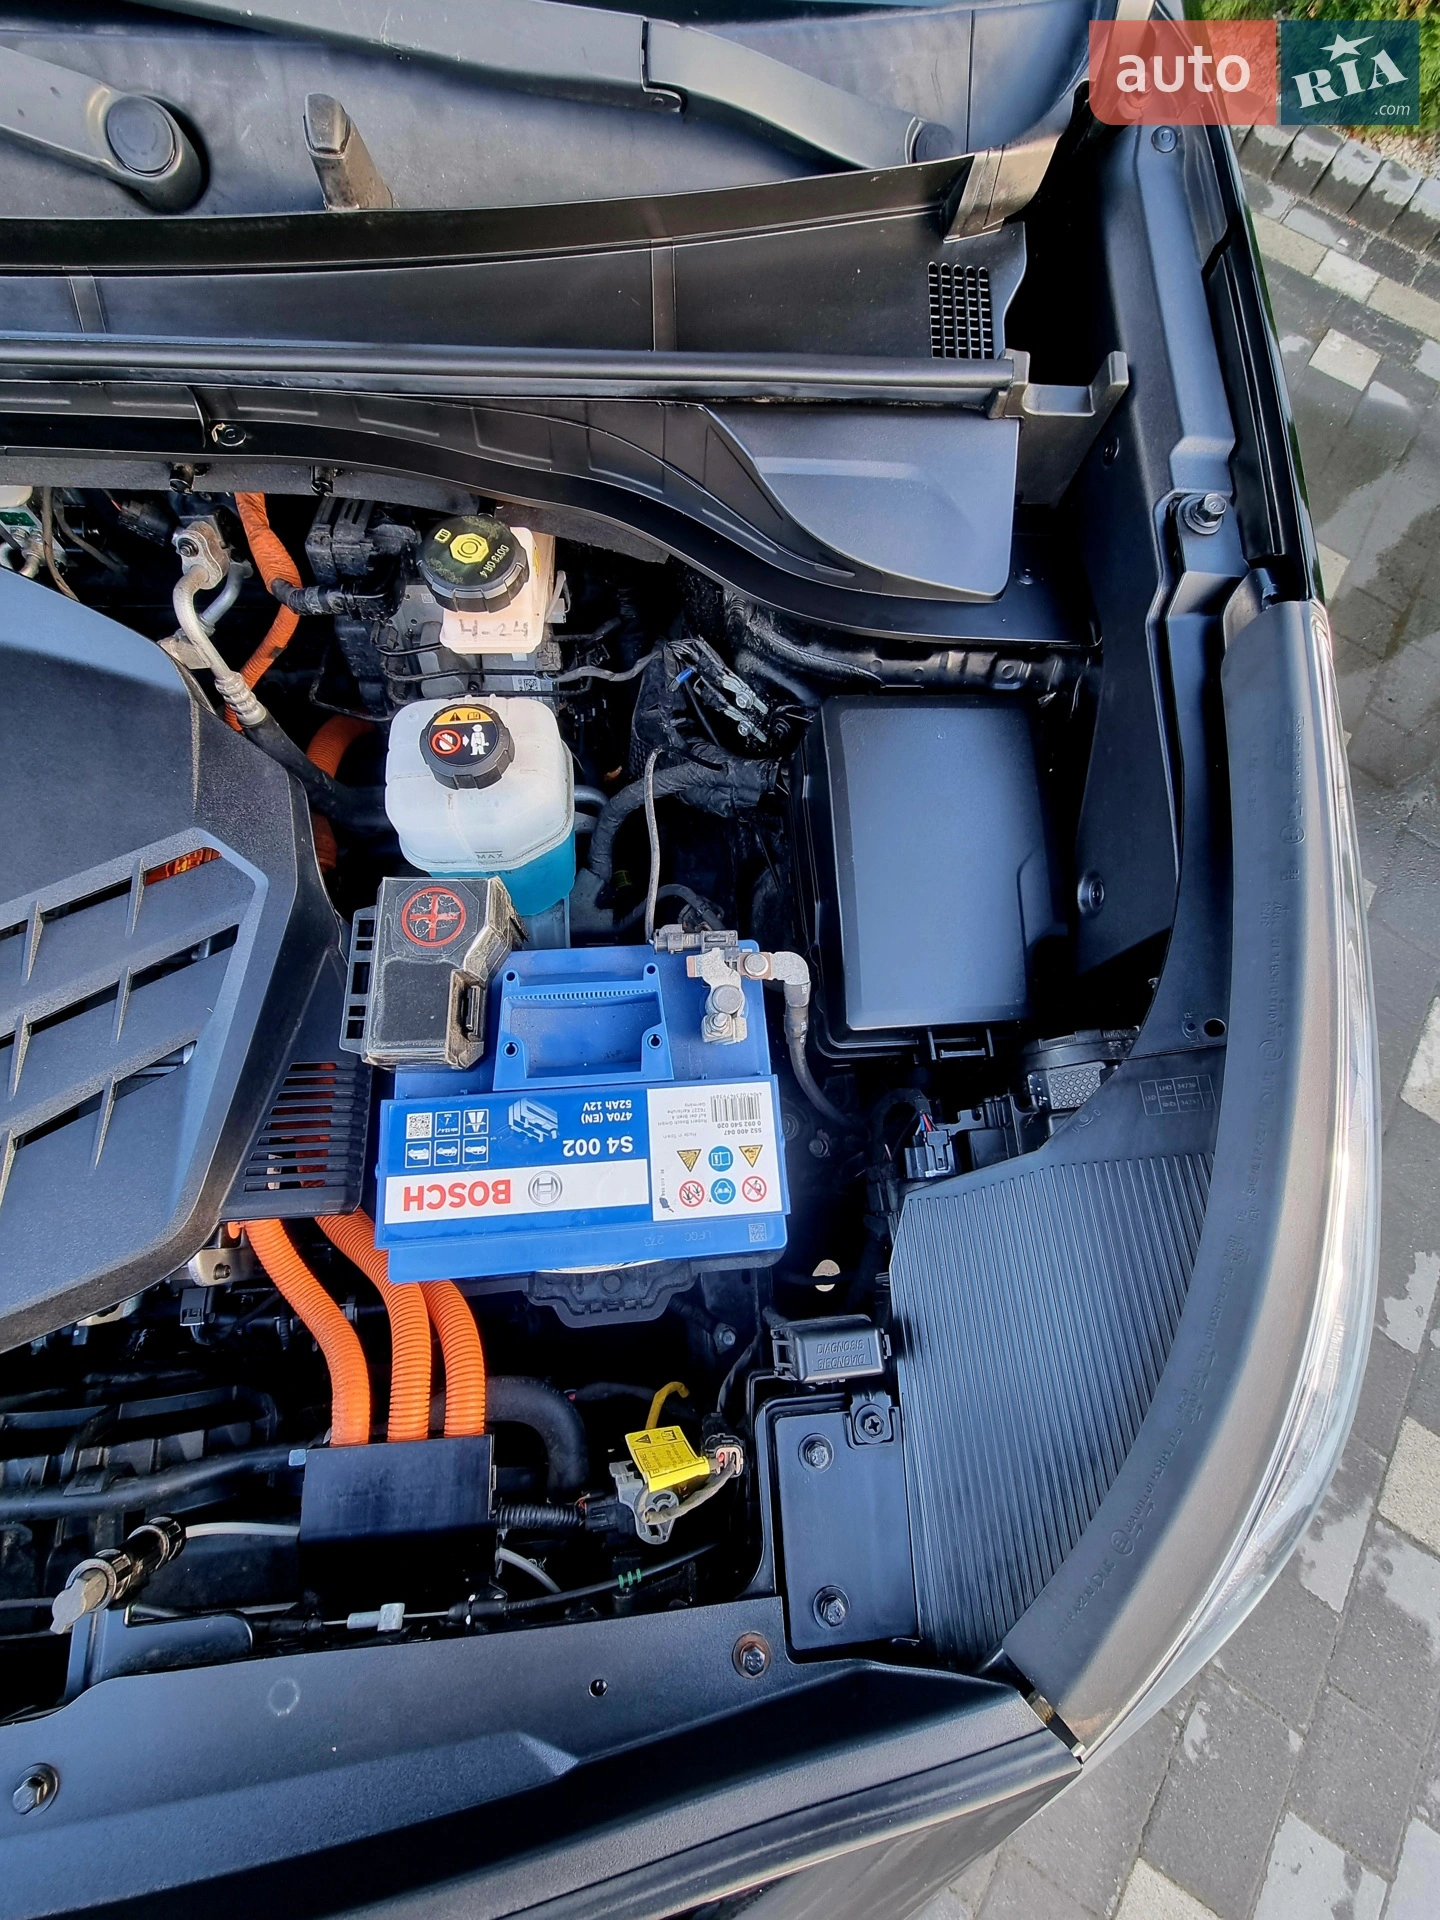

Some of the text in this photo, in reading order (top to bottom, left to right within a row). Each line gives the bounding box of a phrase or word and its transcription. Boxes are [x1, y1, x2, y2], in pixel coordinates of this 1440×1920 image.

[490, 544, 510, 563] DOT3
[485, 561, 496, 573] OR
[582, 1100, 632, 1111] 52Ah 12V
[580, 1112, 632, 1124] 470A (EN)
[562, 1136, 634, 1156] S4 002
[403, 1179, 511, 1212] BOSCH
[816, 1339, 864, 1355] DIAGNOSIS
